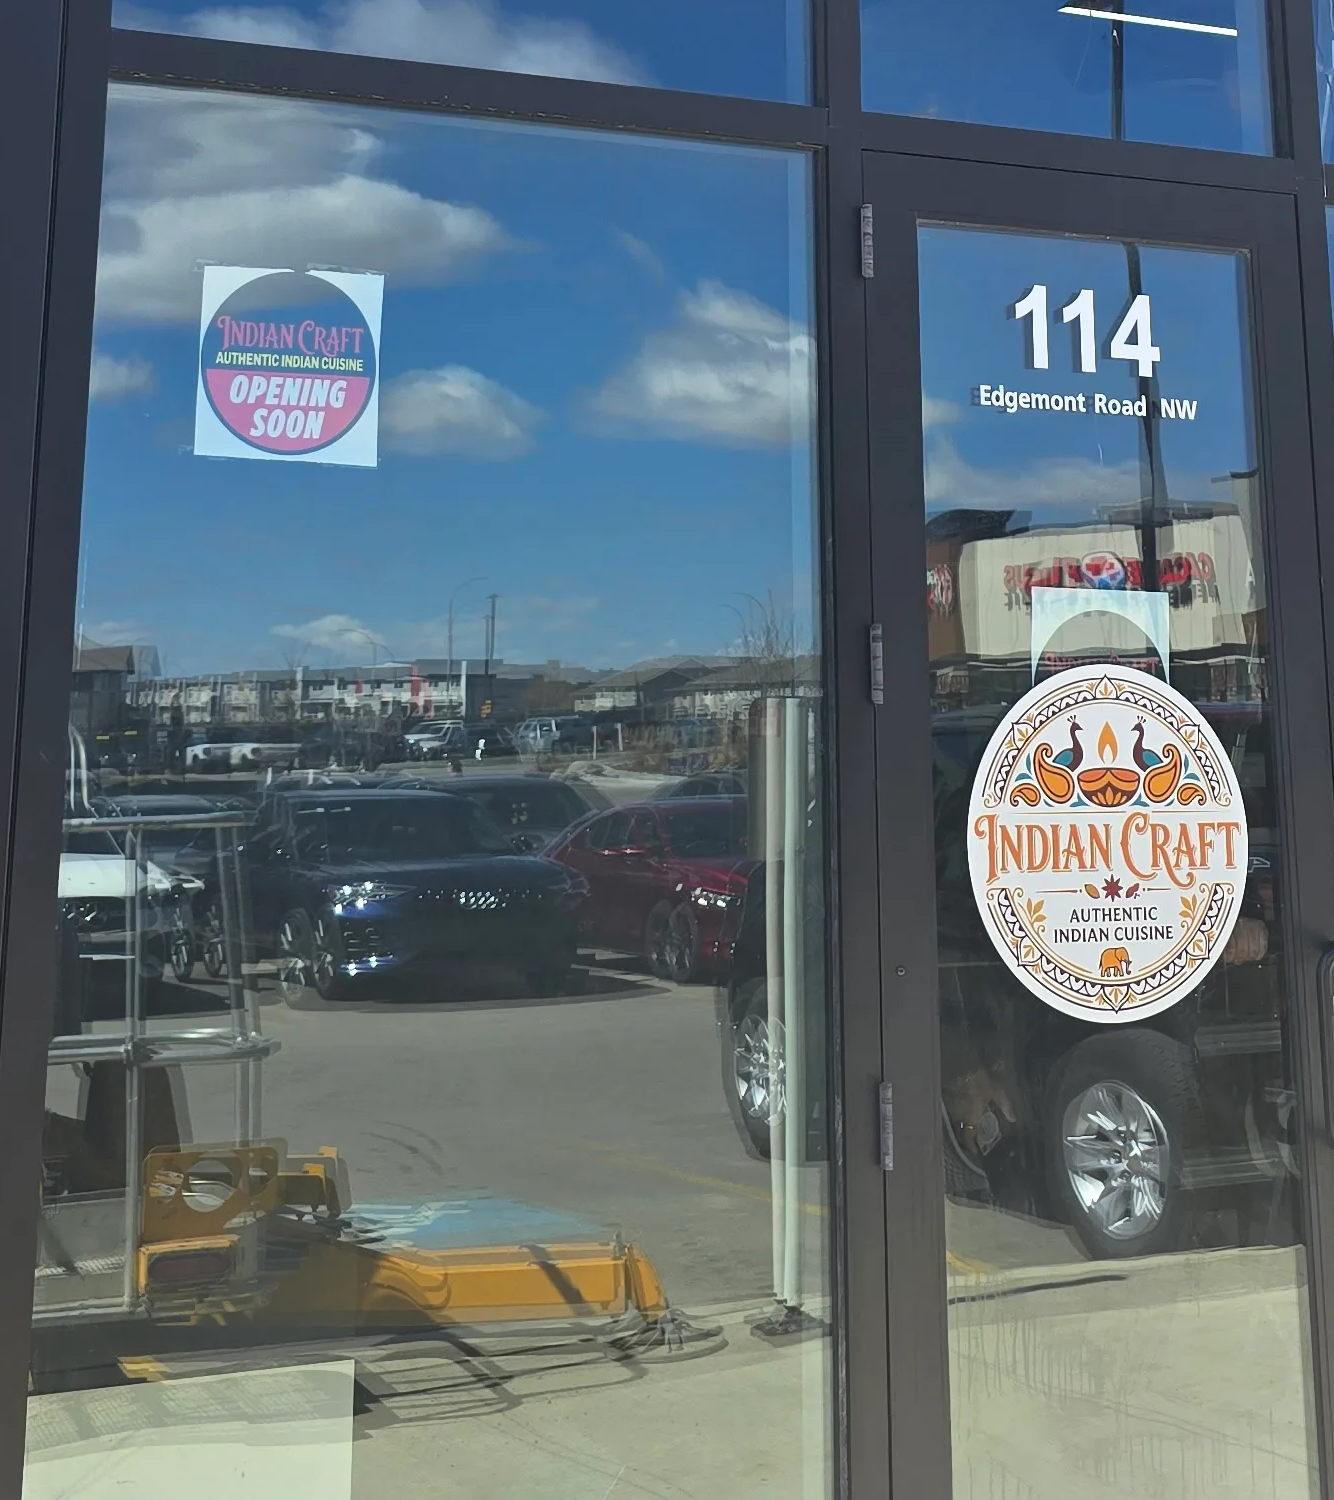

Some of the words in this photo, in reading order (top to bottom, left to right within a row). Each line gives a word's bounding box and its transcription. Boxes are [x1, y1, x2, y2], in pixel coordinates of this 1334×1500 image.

[217, 315, 295, 351] INDIAN
[298, 320, 364, 357] CRAFT
[1013, 284, 1161, 378] 114
[216, 351, 280, 367] AUTHENTIC
[281, 354, 320, 369] INDIAN
[321, 356, 364, 372] CUISINE
[229, 374, 348, 409] OPENING
[979, 384, 1087, 413] Edgemont
[1094, 393, 1147, 417] Road
[1160, 397, 1198, 420] NW
[250, 407, 326, 439] SOON
[974, 813, 1113, 886] INDIAN
[1120, 811, 1242, 890] CRAFT
[1069, 905, 1158, 924] AUTHENTIC
[1053, 925, 1111, 944] INDIAN
[1113, 924, 1175, 943] CUISINE
